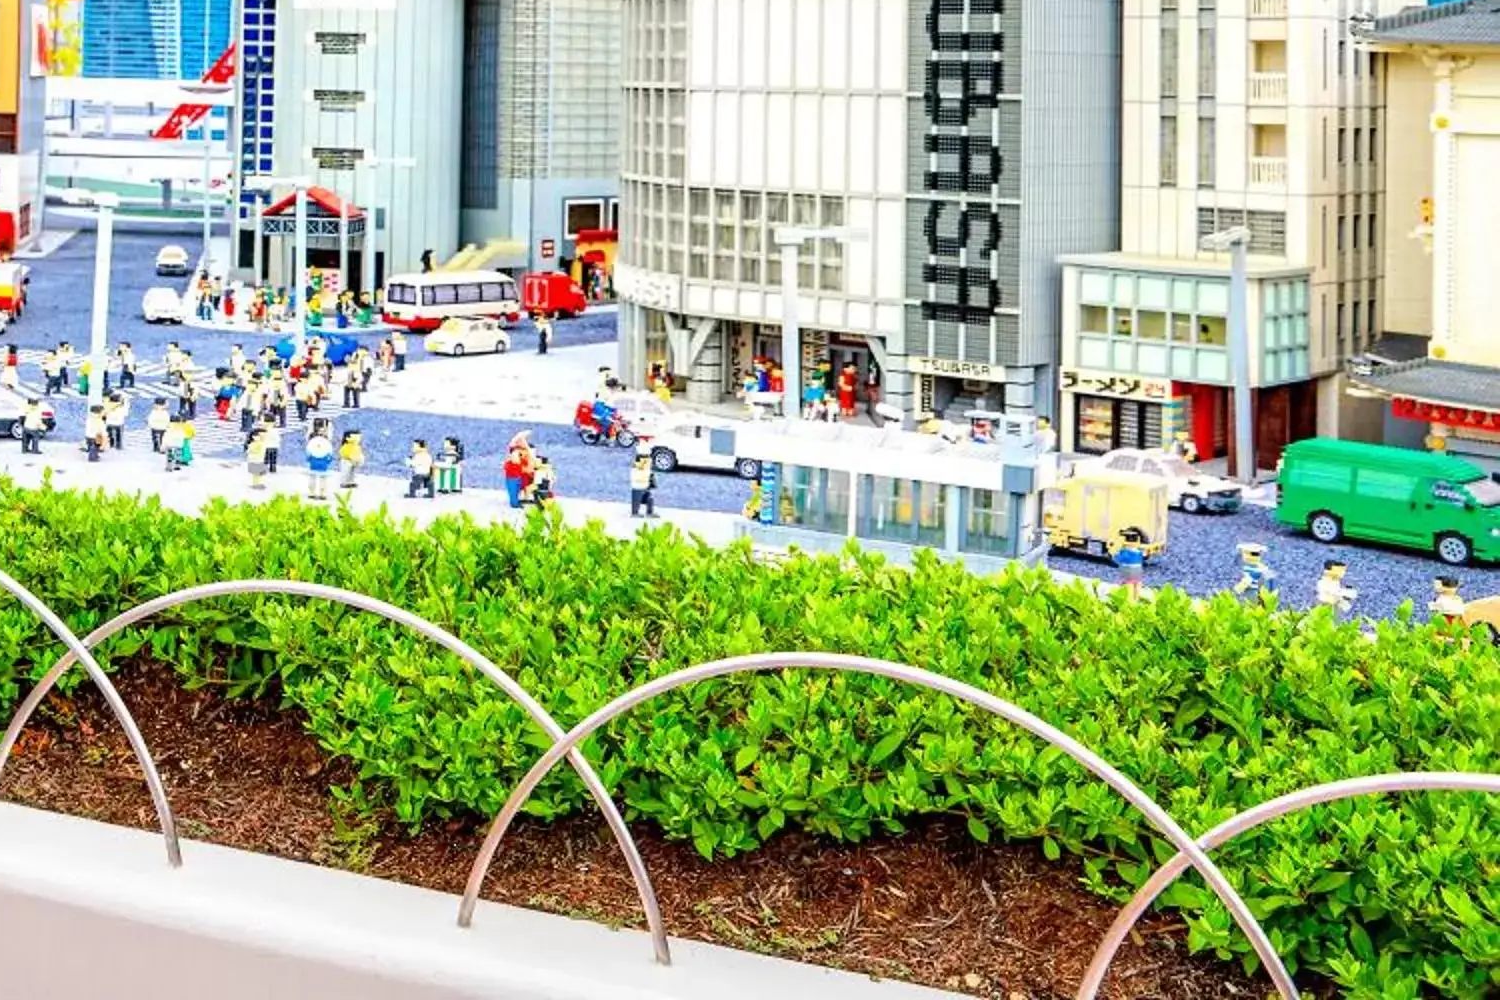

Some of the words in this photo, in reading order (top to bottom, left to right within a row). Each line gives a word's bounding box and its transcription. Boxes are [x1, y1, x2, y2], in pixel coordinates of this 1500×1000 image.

[920, 359, 990, 377] TSUBASA
[1062, 371, 1141, 395] ラーメン
